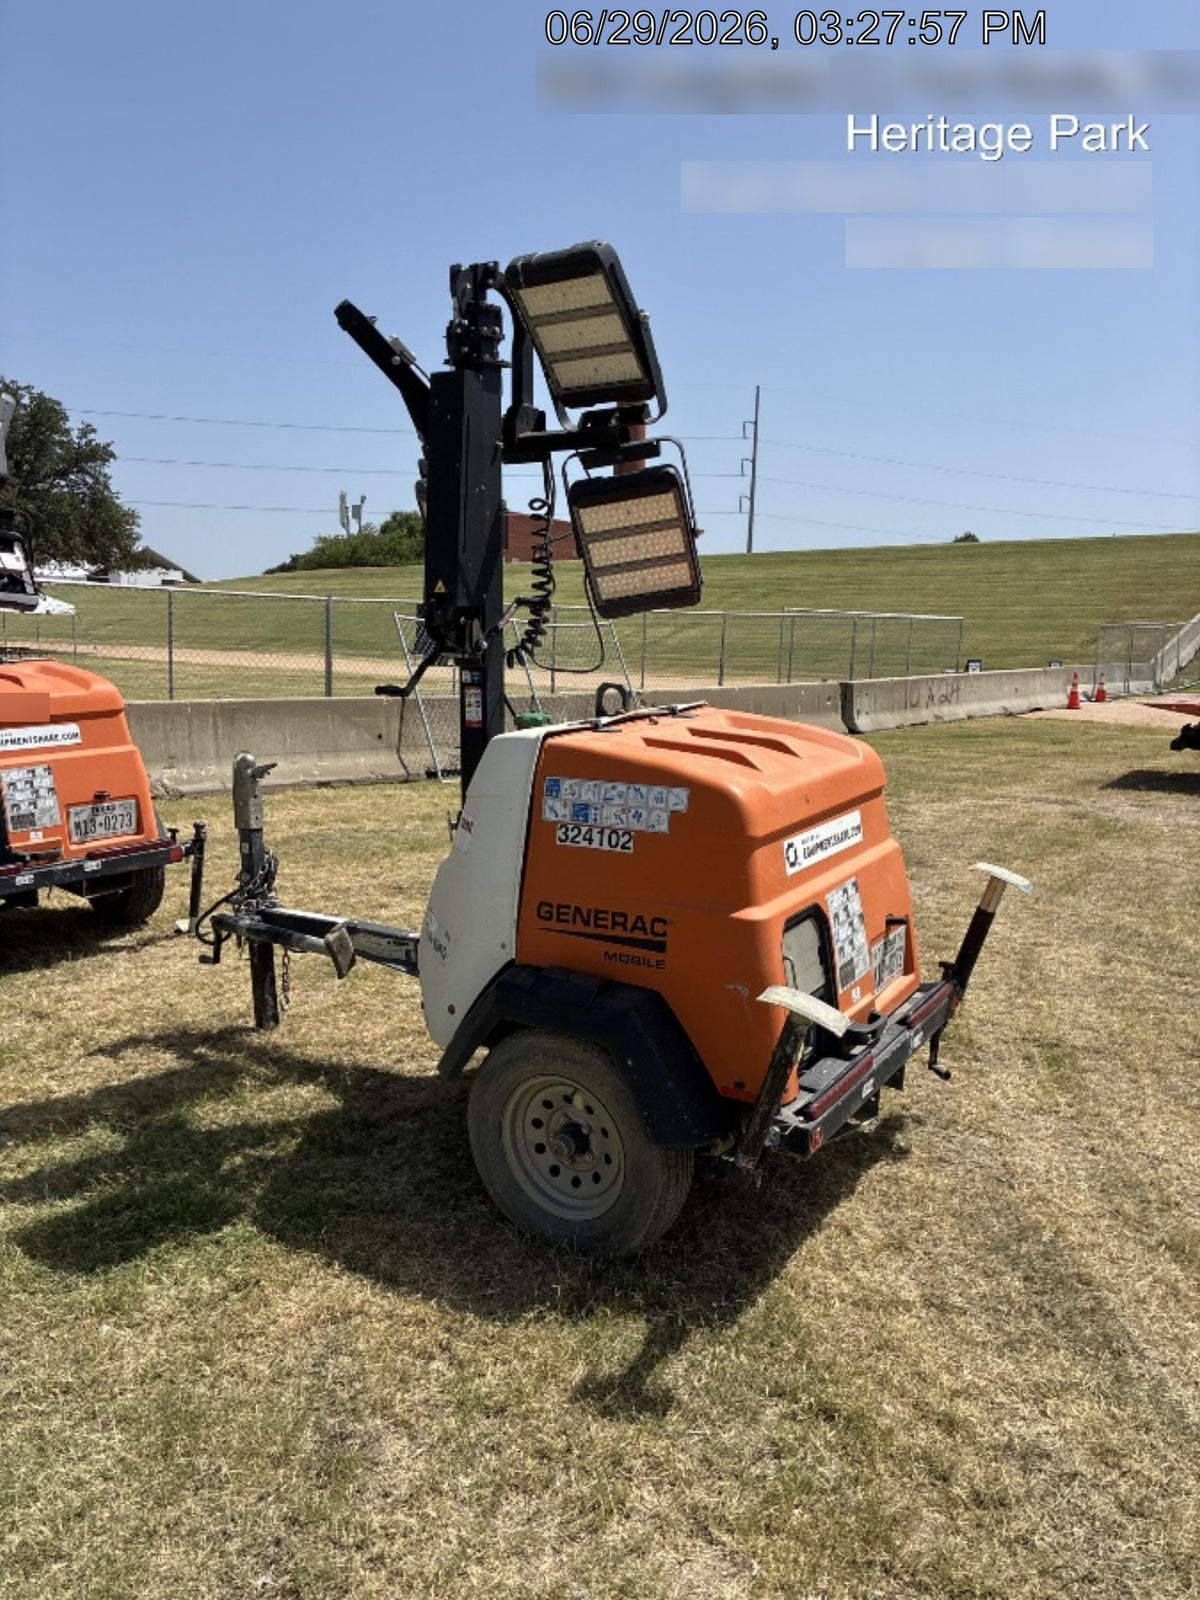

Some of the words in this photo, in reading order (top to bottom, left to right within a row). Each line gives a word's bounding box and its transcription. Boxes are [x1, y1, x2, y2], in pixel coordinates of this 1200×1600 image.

[557, 824, 633, 852] 324102
[536, 901, 668, 938] GENERAC
[603, 950, 666, 969] MOBILE
